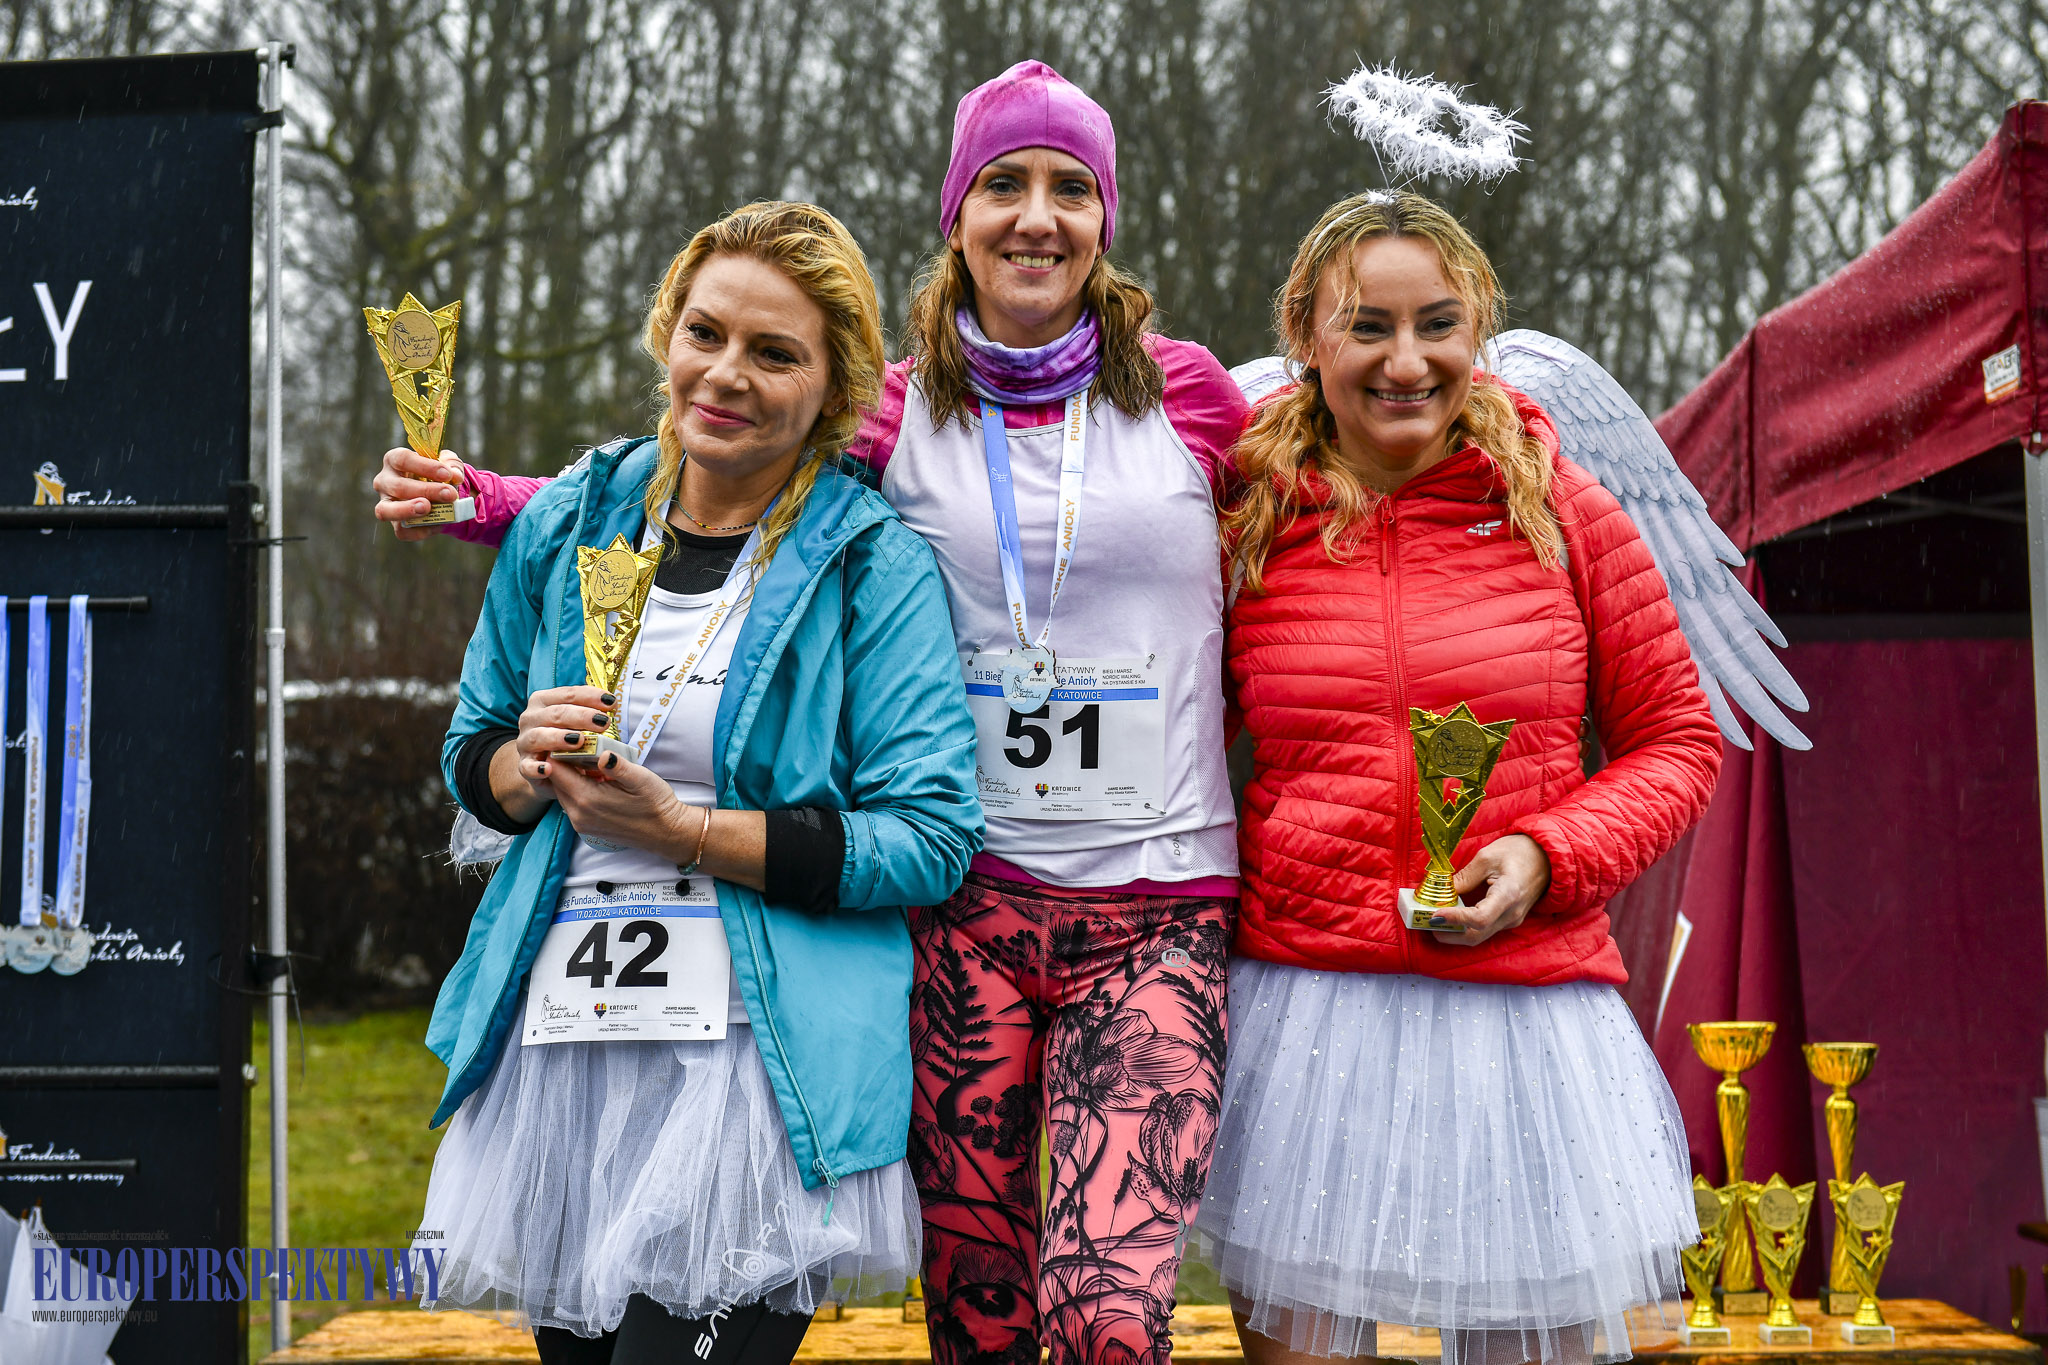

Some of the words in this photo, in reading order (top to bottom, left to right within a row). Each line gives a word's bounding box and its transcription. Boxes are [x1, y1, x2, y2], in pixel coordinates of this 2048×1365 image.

[659, 652, 698, 708] ŚLĄSKIE
[697, 600, 728, 649] ANIOŁY
[986, 670, 1002, 682] Bieg
[1068, 675, 1098, 687] Anioły
[1057, 691, 1103, 699] KATOWICE
[1003, 703, 1100, 770] 51
[570, 894, 600, 906] Fundacji
[627, 890, 657, 903] Anioły
[576, 908, 611, 919] 17.02.2024
[618, 906, 662, 916] KATOWICE
[566, 919, 670, 989] 42
